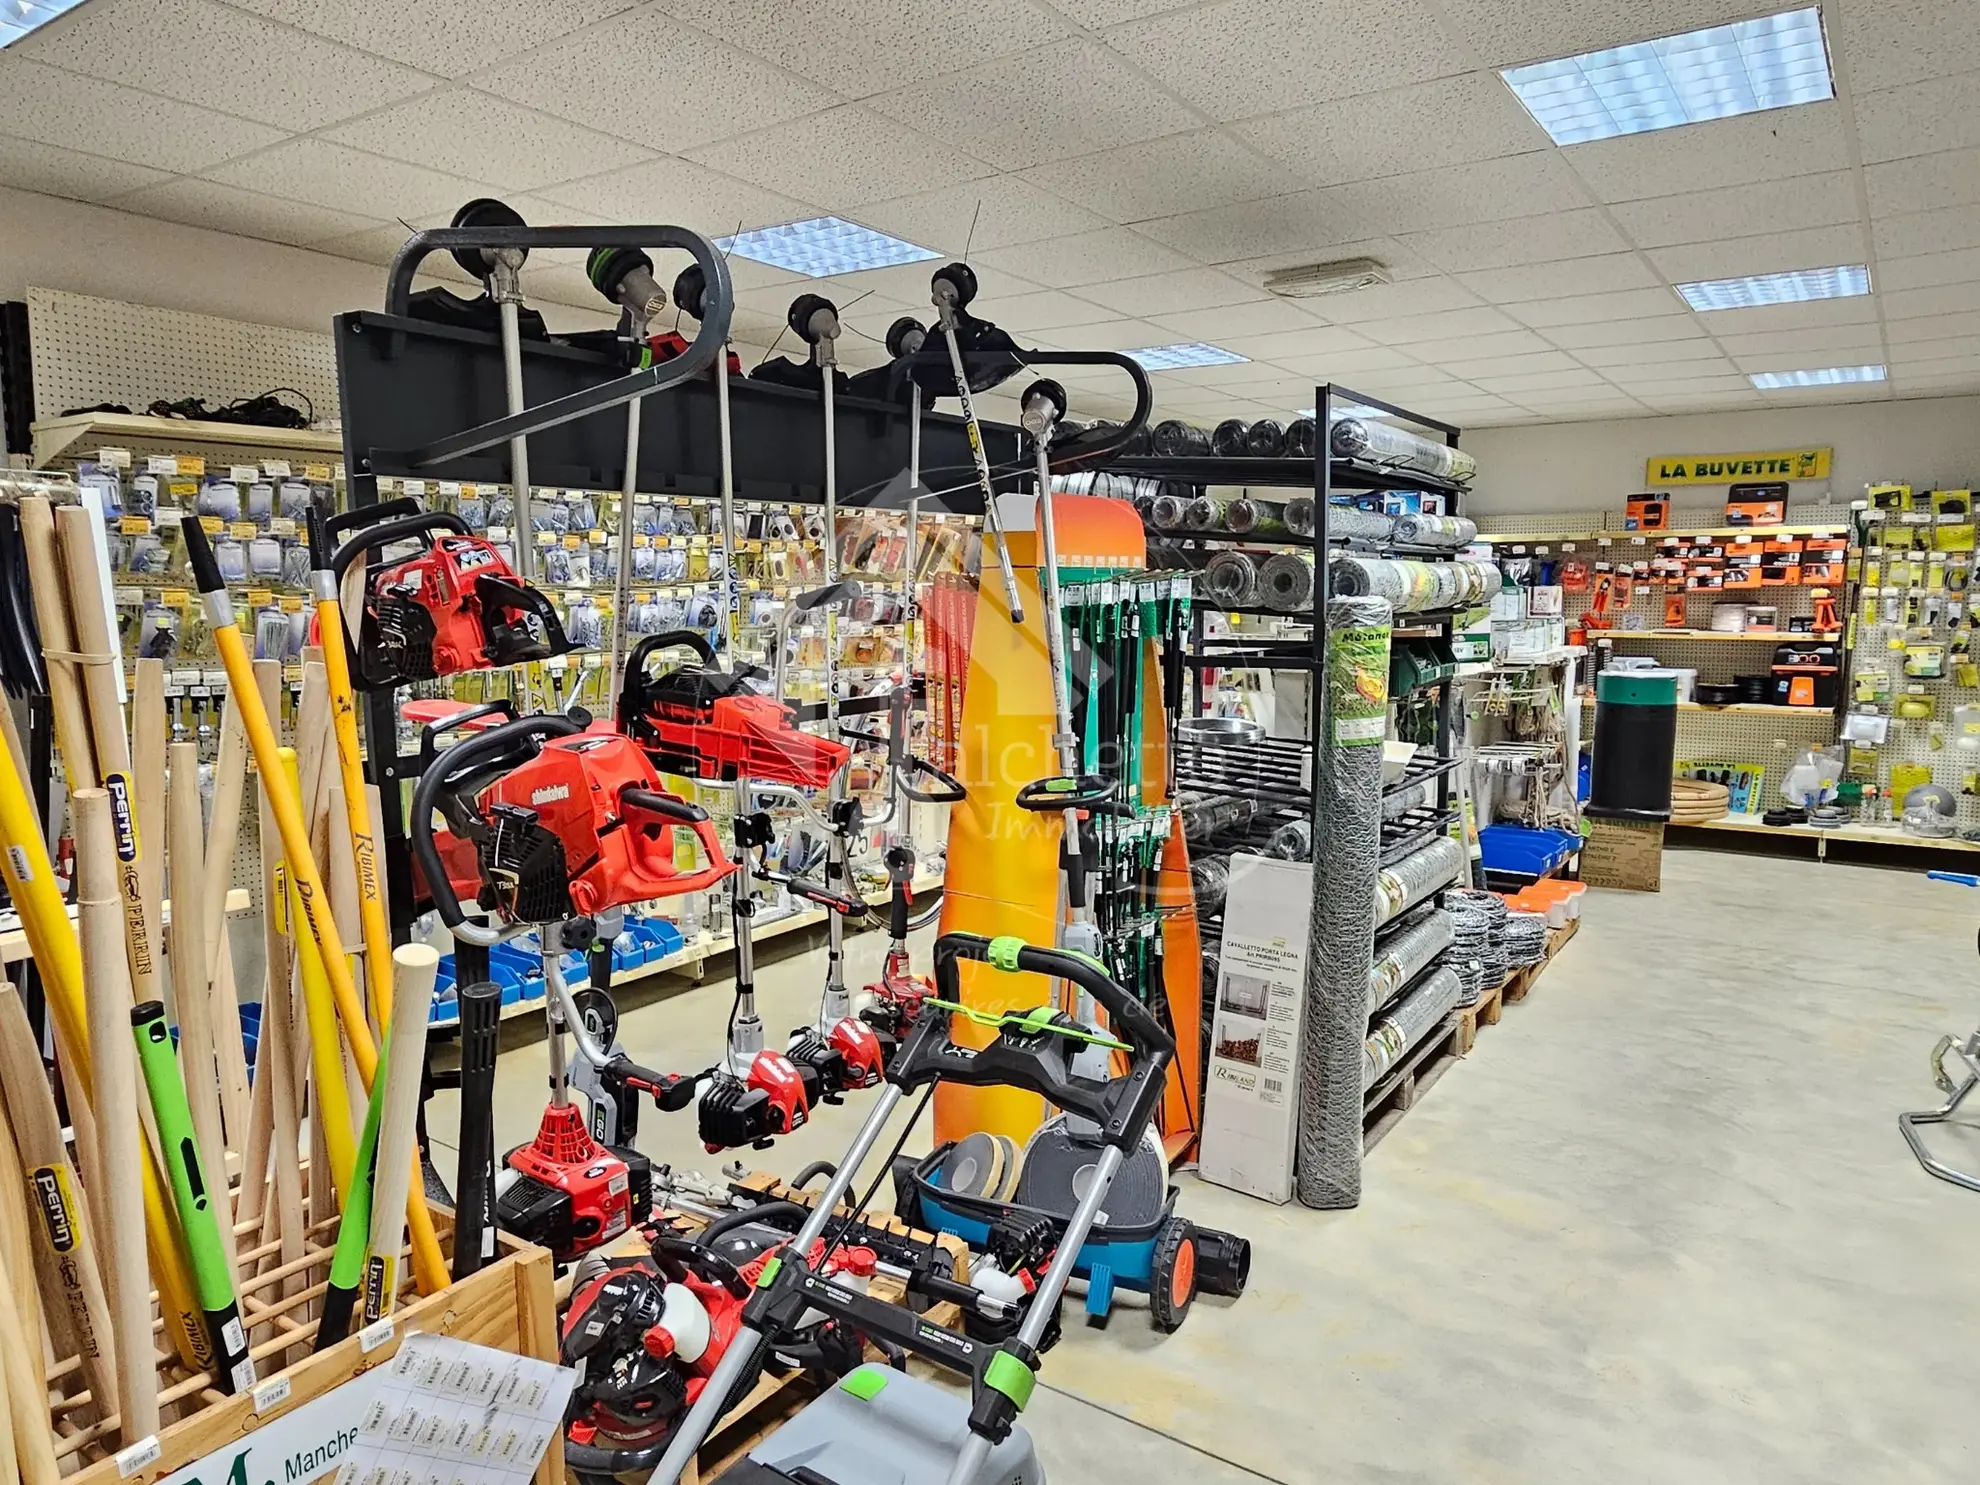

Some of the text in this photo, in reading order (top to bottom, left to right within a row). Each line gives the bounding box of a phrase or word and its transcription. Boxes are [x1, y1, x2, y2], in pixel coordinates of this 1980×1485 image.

[1660, 458, 1790, 479] LA BUVETTE
[355, 831, 377, 900] RIBIMEX
[127, 903, 152, 976] PERRIN
[1226, 940, 1261, 953] CAVALLETTO
[596, 1109, 605, 1140] EGO
